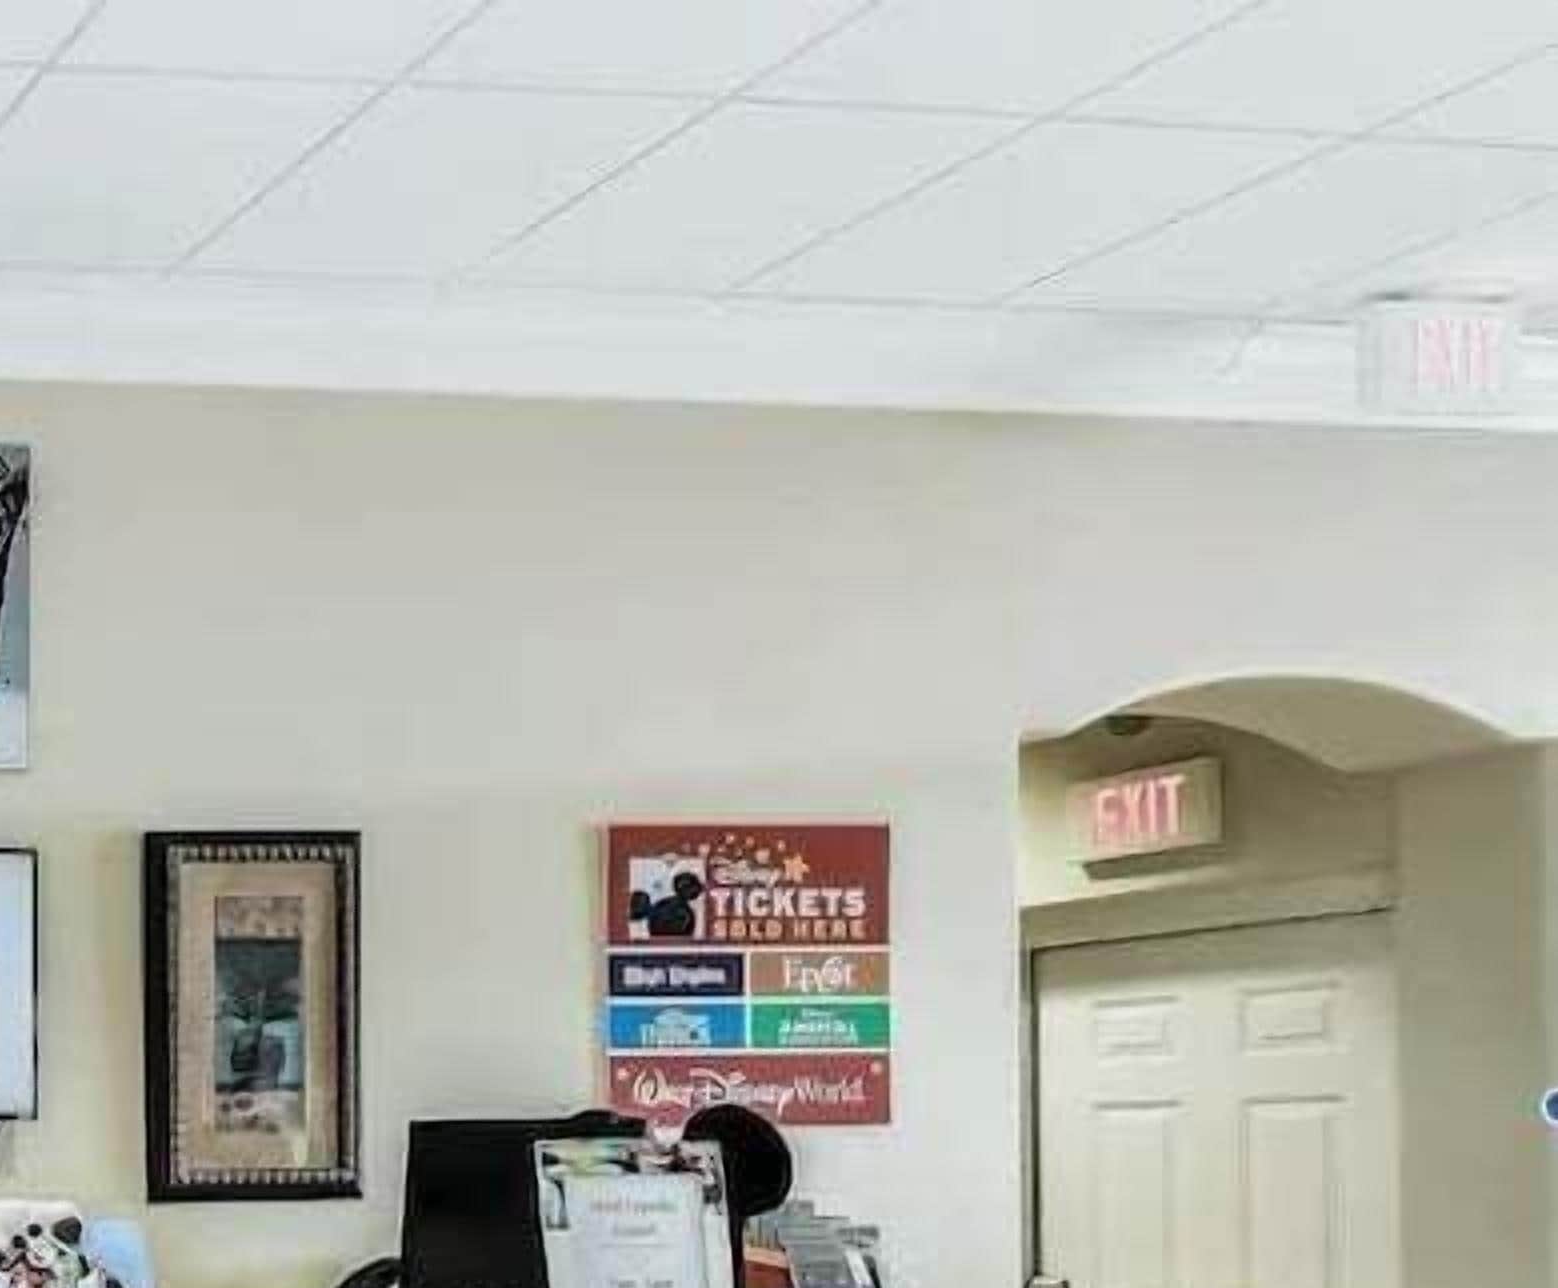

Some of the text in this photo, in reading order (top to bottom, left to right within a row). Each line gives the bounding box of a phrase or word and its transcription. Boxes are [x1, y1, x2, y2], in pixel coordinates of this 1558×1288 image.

[1093, 774, 1187, 841] EXIT
[709, 887, 866, 918] TICKETS
[712, 919, 867, 940] SOLD HERE
